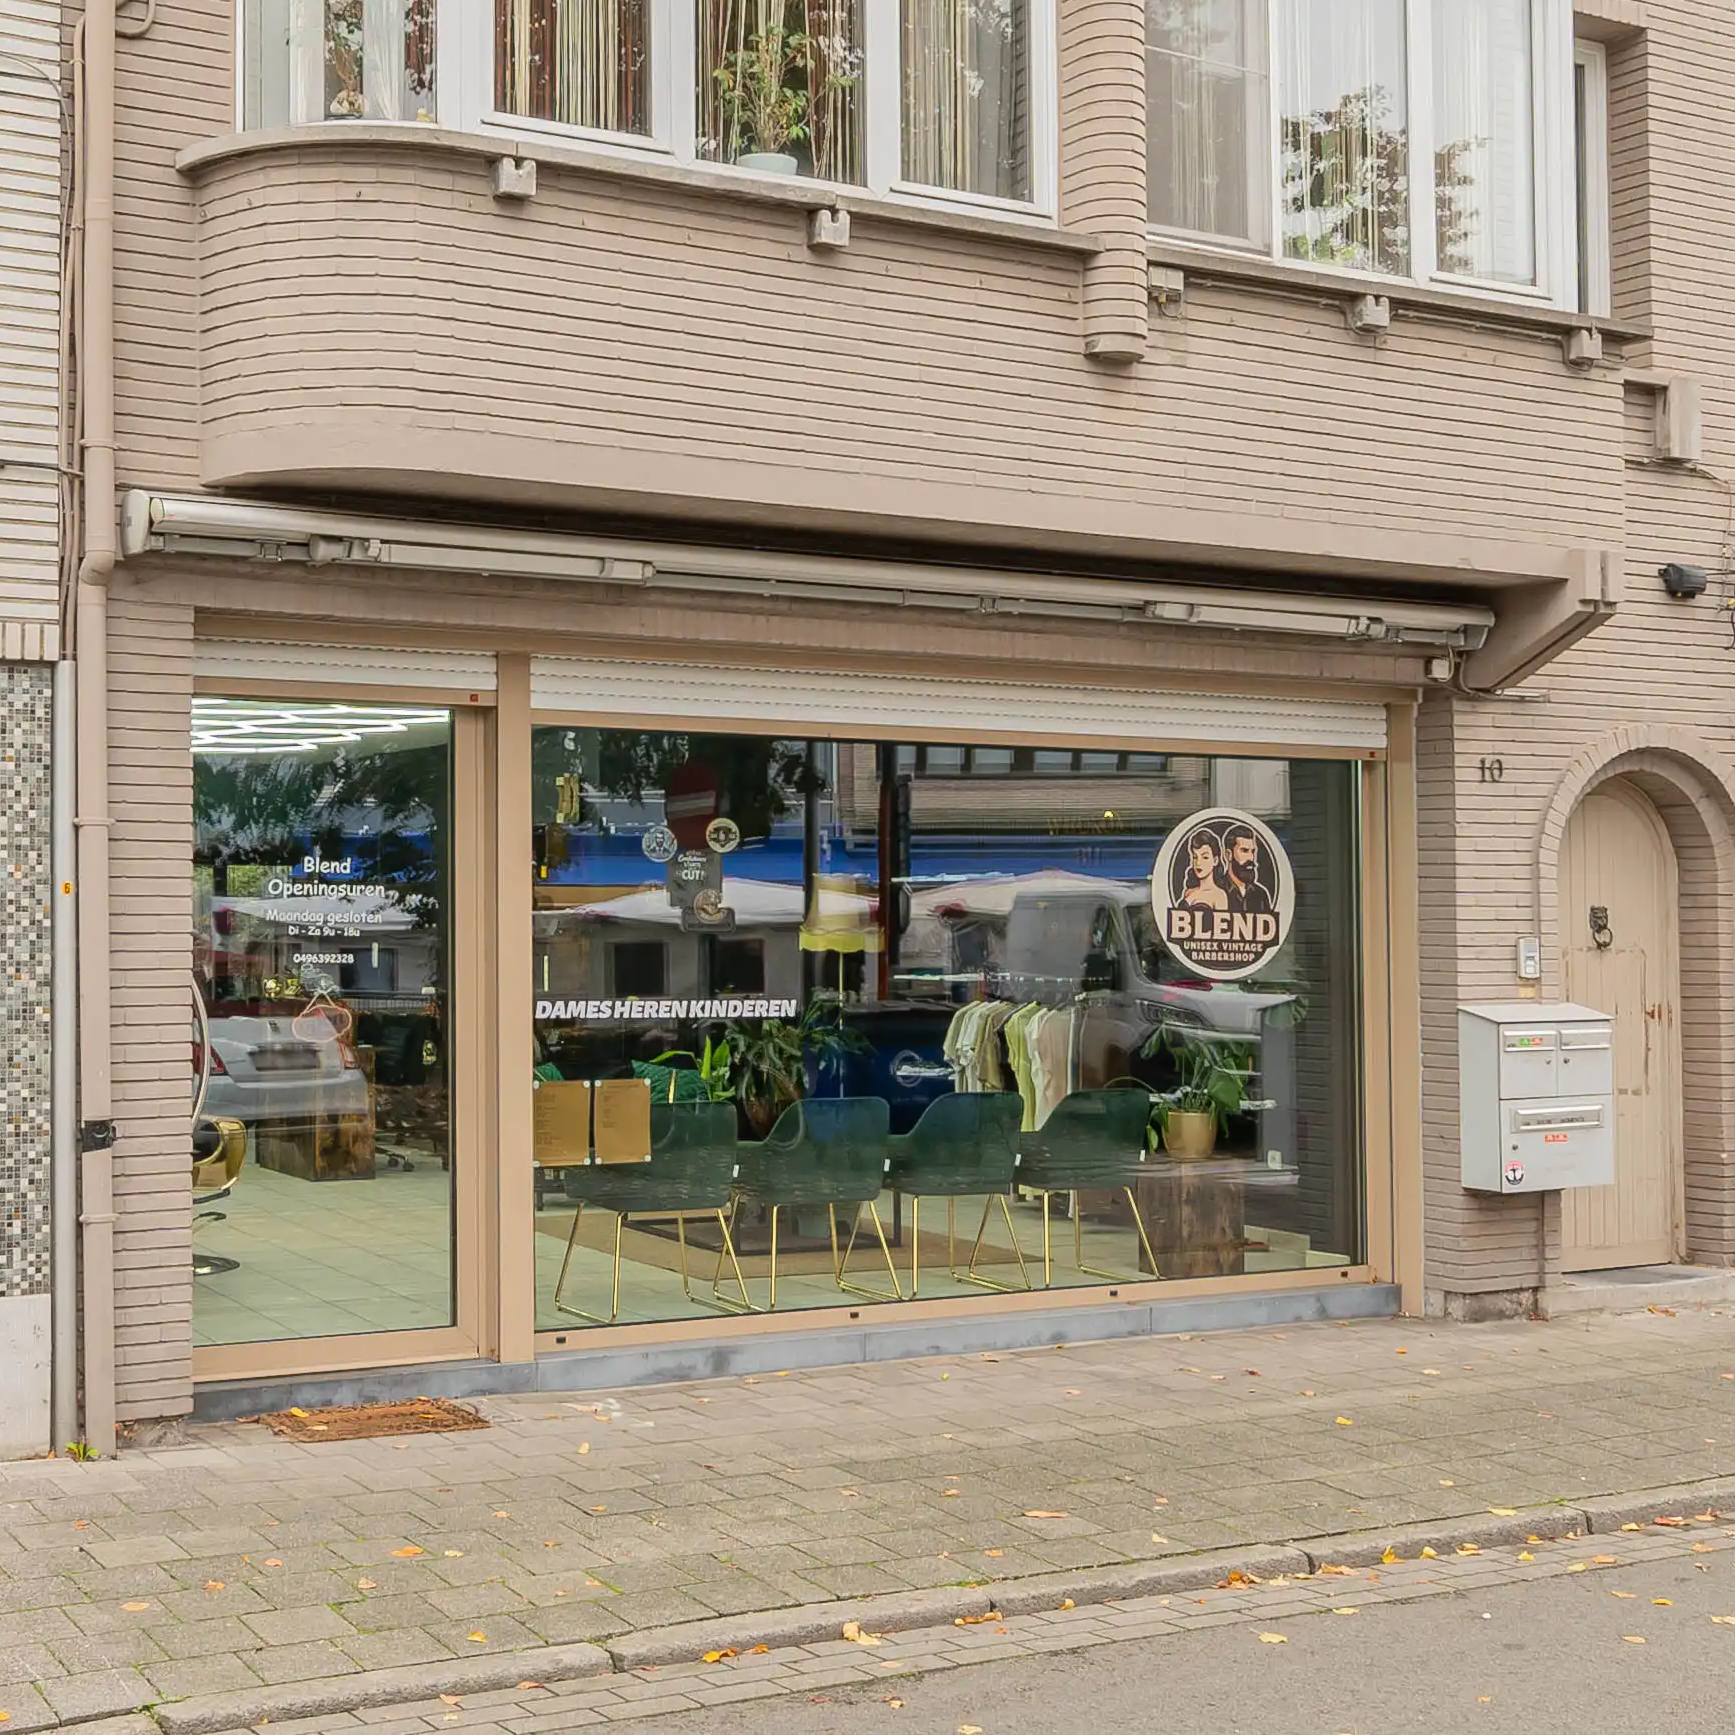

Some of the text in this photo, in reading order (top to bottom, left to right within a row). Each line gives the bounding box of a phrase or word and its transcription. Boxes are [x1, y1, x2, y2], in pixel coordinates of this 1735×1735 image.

[1479, 757, 1503, 783] 10
[303, 856, 352, 874] Blend
[267, 878, 385, 900] Openingsuren
[265, 908, 383, 925] Maandag gesloten
[1170, 909, 1277, 941] BLEND
[288, 925, 299, 936] Di
[307, 926, 321, 936] Za
[322, 926, 335, 936] 9u
[343, 927, 360, 937] 18u
[1183, 941, 1263, 952] UNISEX VINTAGE
[1191, 951, 1255, 962] BARBERSHOP
[535, 999, 798, 1019] DAMES HEREN KINDEREN
